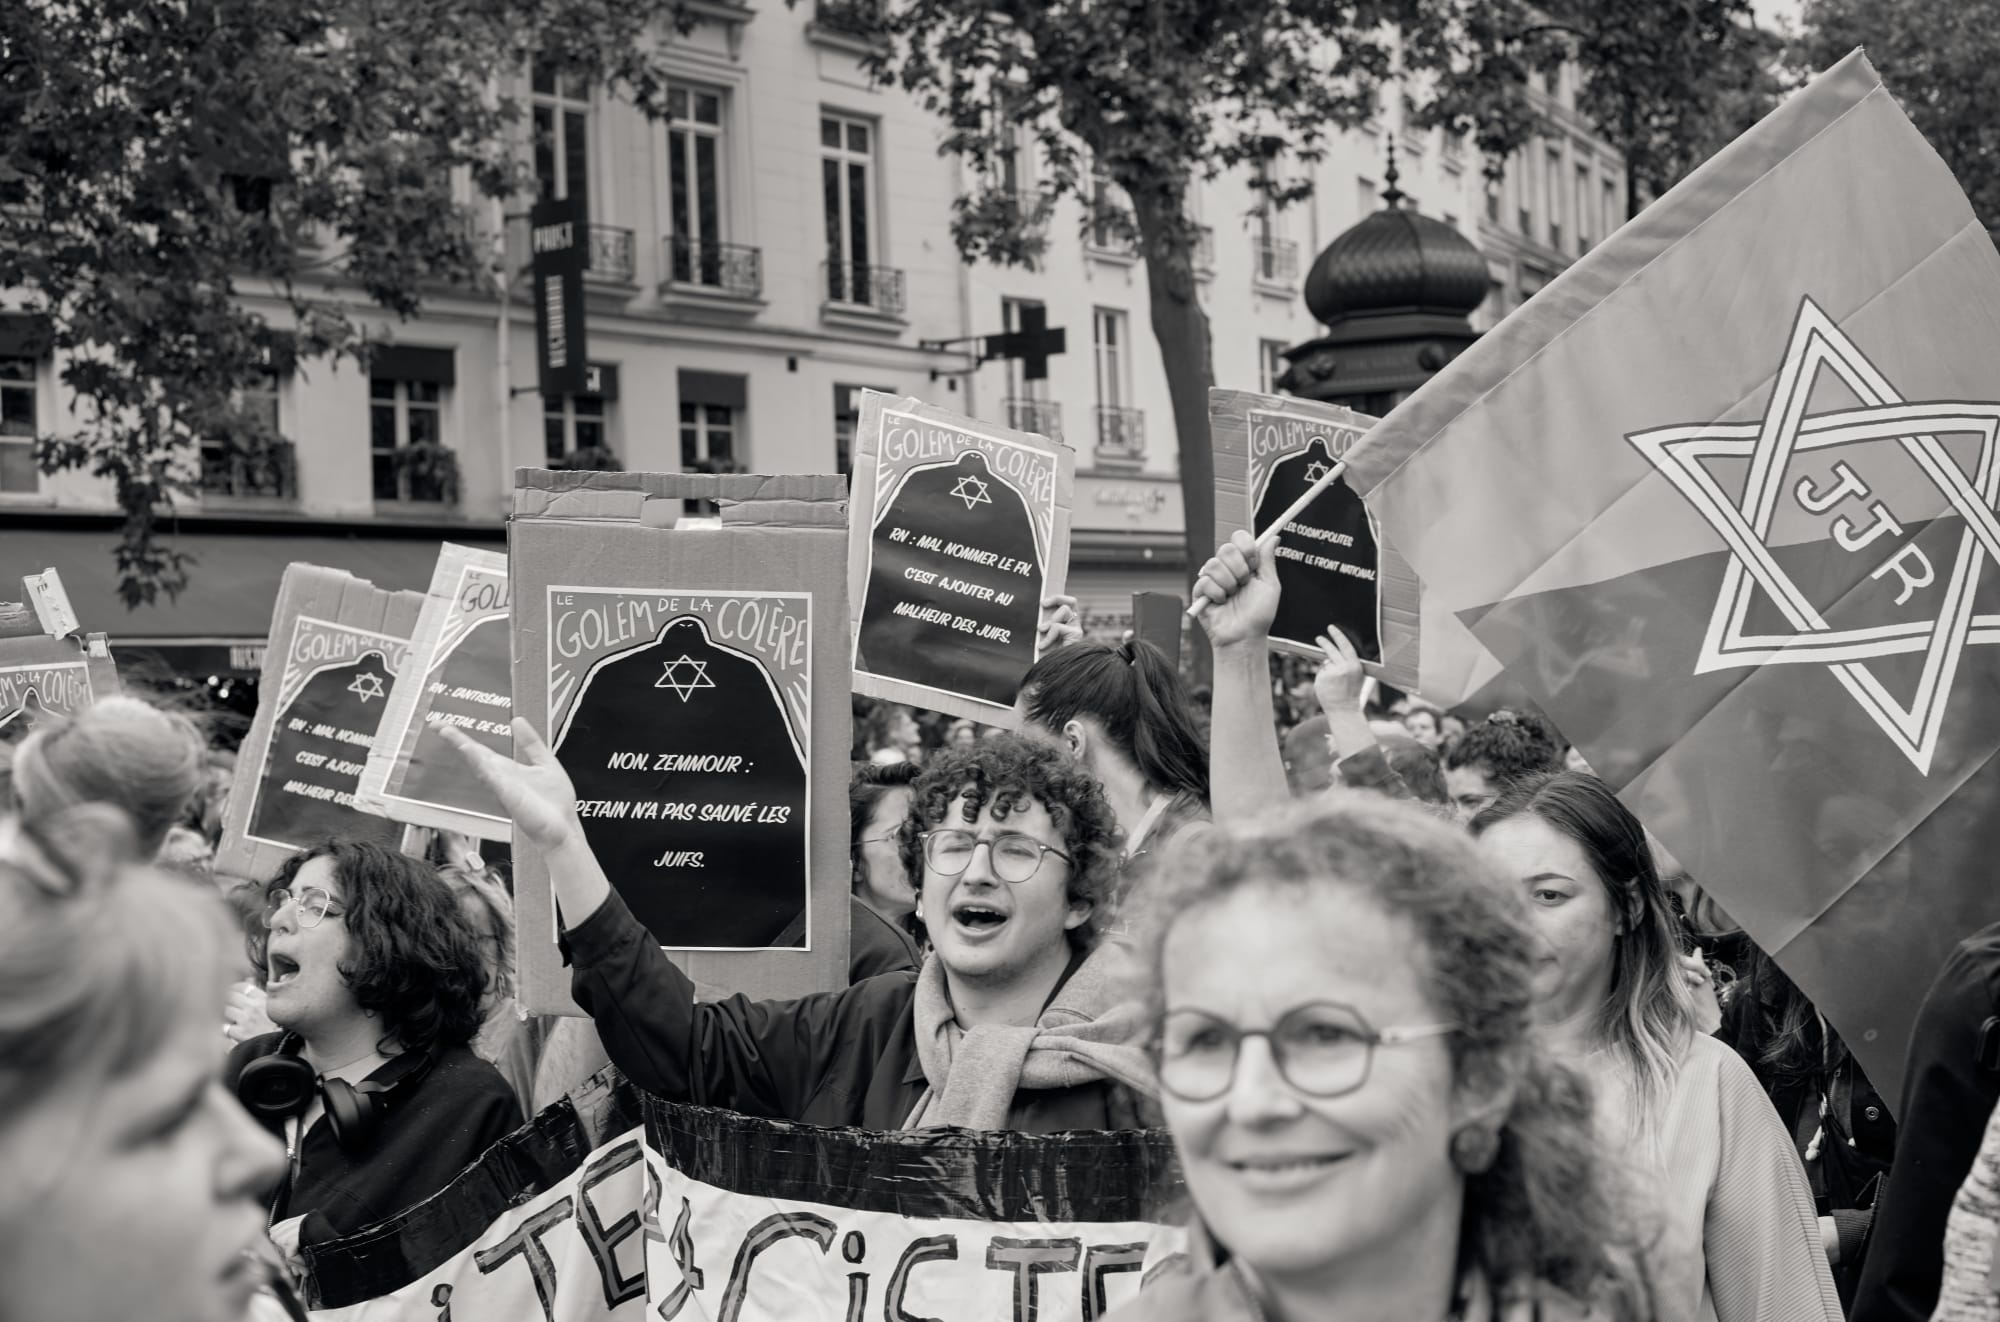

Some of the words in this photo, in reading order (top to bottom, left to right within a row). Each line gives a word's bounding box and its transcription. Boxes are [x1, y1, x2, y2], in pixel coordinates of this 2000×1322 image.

[887, 415, 900, 425] LE
[884, 427, 955, 462] GOLEM
[956, 433, 971, 446] DE
[977, 439, 995, 452] LA
[1252, 421, 1307, 457] GOLEM
[1305, 422, 1317, 434] DE
[1319, 425, 1333, 436] LA
[995, 446, 1054, 503] COLÈRE
[1296, 523, 1355, 548] COSMOPOLITES
[1793, 459, 1935, 606] JJR
[888, 527, 910, 543] RN
[915, 534, 943, 553] MAL
[943, 541, 999, 567] NOMMER
[997, 556, 1016, 571] LE
[1304, 553, 1316, 565] LE
[1313, 556, 1340, 571] FRONT
[1338, 562, 1377, 581] NATIONAL
[460, 583, 510, 613] GOL
[904, 566, 939, 585] C'EST
[937, 576, 995, 601] AJOUTER
[994, 591, 1015, 607] AU
[556, 594, 575, 606] LE
[657, 597, 680, 613] DE
[689, 597, 714, 613] LA
[555, 600, 655, 658] GOLEM
[716, 598, 808, 671] COLÈRE
[892, 601, 953, 627] MALHEUR
[951, 616, 978, 634] DES
[976, 623, 1012, 645] JUIFS.
[294, 633, 358, 663] GOLEM
[359, 636, 373, 647] DE
[379, 640, 394, 651] LA
[28, 671, 41, 683] LA
[428, 681, 448, 694] RN
[287, 717, 308, 732] RN
[311, 723, 337, 739] MAL
[425, 710, 445, 723] UN
[475, 719, 496, 732] DE
[295, 750, 329, 768] C'EST
[324, 757, 366, 777] AJOUT
[652, 753, 743, 773] ZEMMOUR
[282, 779, 336, 802] MALHEUR
[575, 799, 631, 819] PETAIN
[630, 801, 659, 819] N'A
[660, 802, 697, 822] PAS
[697, 802, 758, 823] SAUVÉ
[757, 805, 792, 823] LES
[653, 850, 706, 868] JUIFS.
